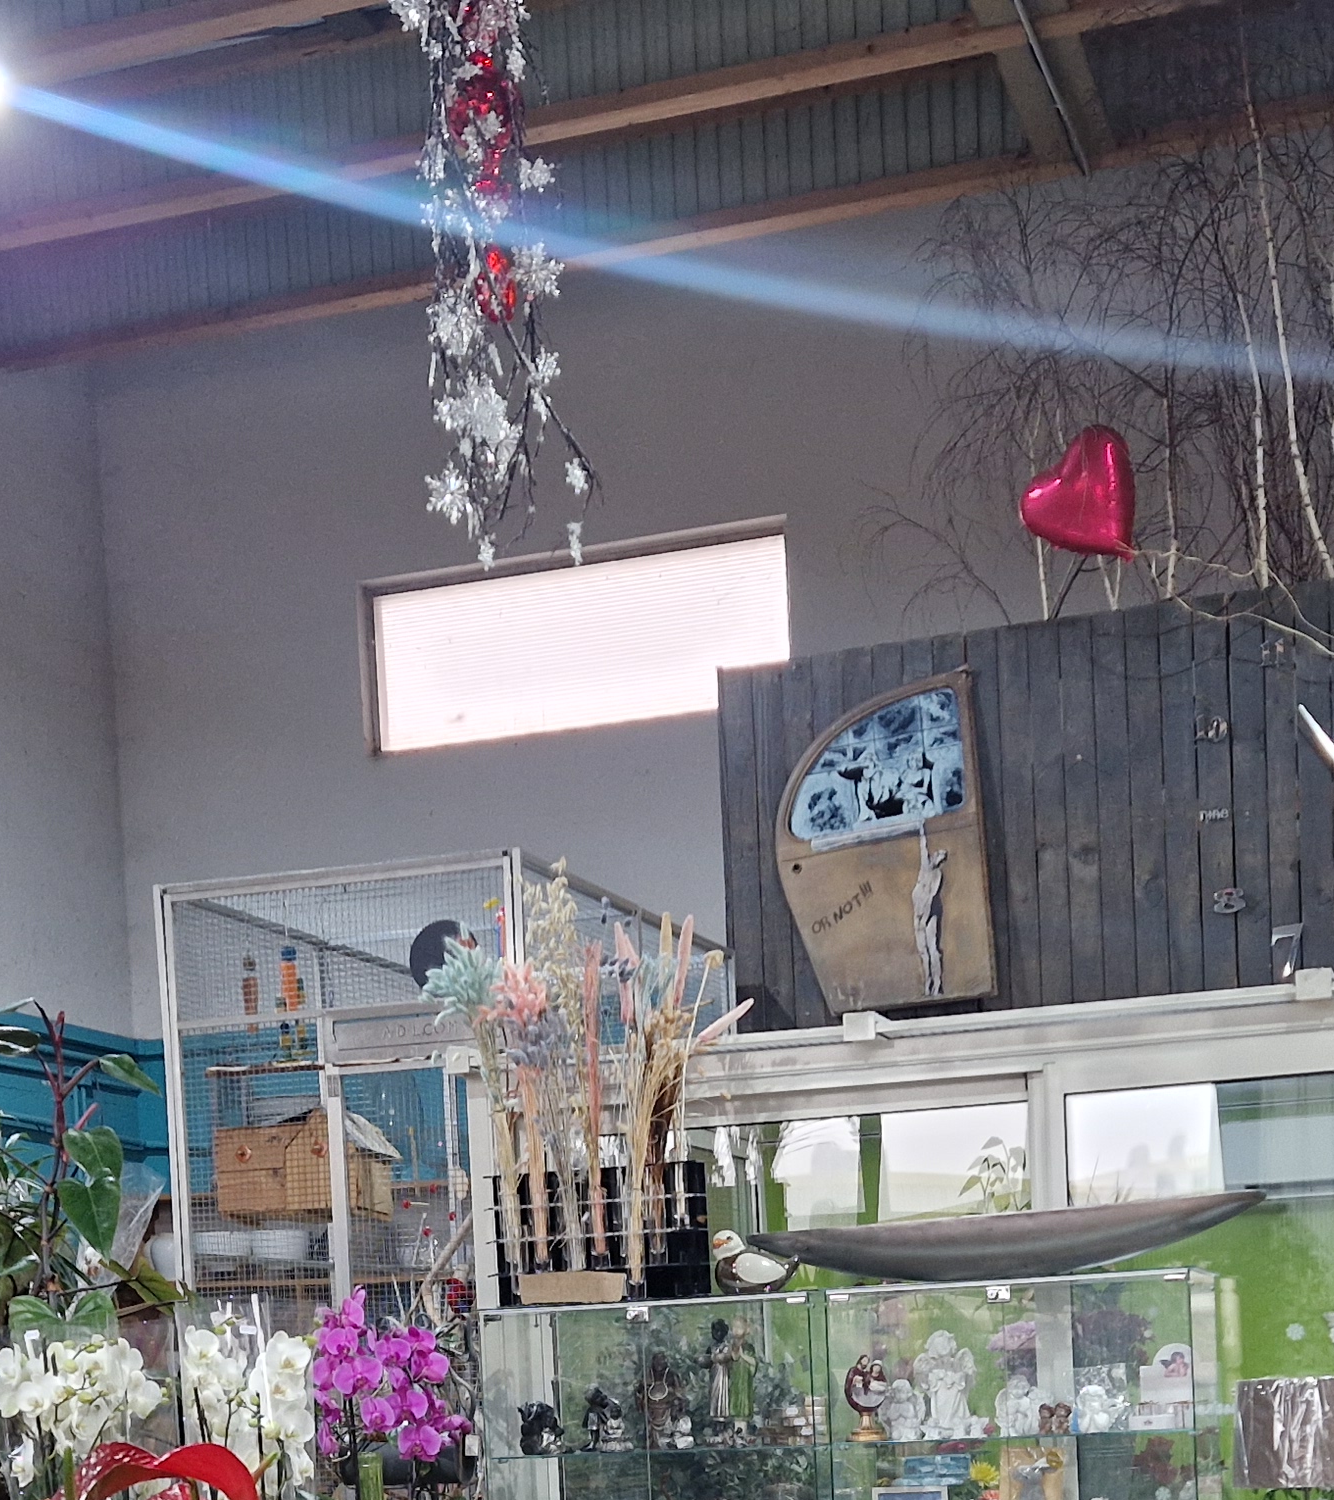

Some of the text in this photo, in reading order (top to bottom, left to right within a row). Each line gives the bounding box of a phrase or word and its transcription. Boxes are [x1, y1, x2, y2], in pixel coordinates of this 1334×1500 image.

[1212, 886, 1247, 915] 8
[812, 916, 831, 934] OR
[1270, 922, 1304, 978] 7
